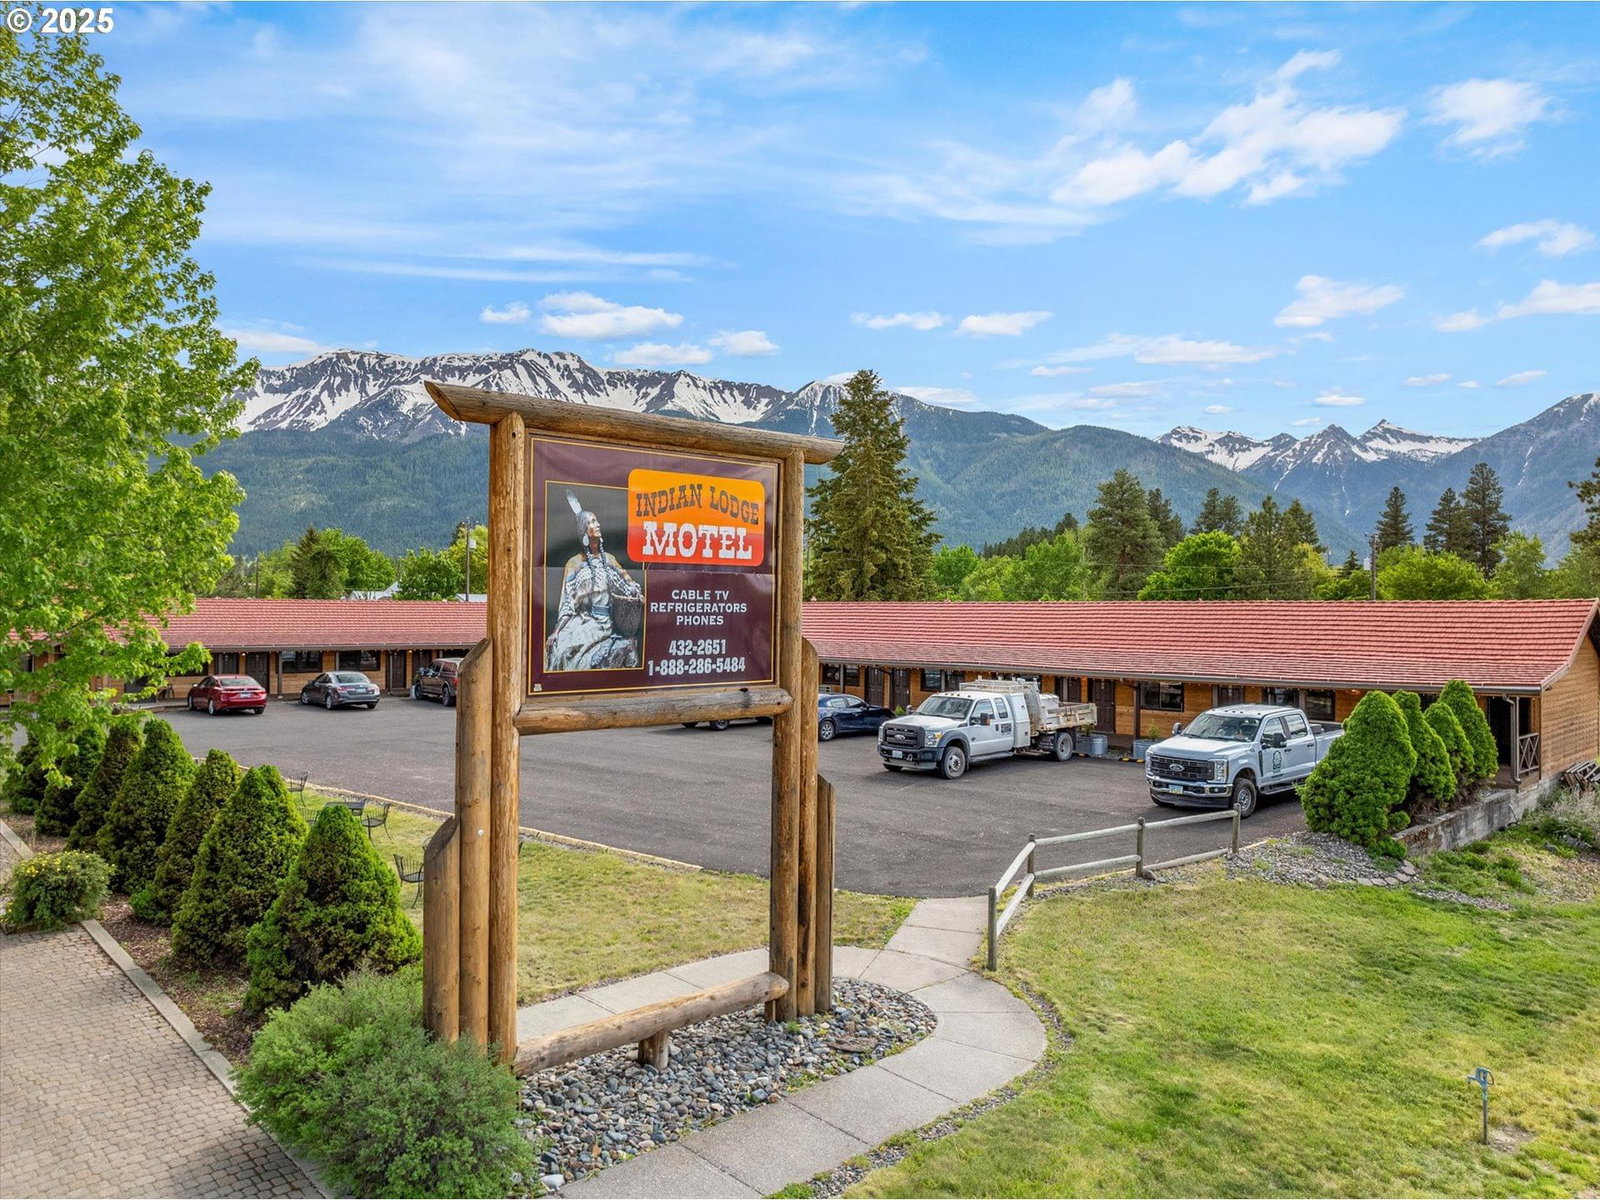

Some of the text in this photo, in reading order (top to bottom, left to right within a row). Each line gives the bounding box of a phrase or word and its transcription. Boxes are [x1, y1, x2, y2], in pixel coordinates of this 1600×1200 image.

[636, 484, 759, 525] INDIAN LODGE
[642, 521, 752, 560] MOTEL
[671, 590, 729, 600] CABLE TV
[650, 602, 748, 613] REFRIGERATORS
[676, 615, 724, 625] PHONES
[668, 639, 726, 656] 432-2651
[647, 656, 746, 676] 1-888-286-5484
